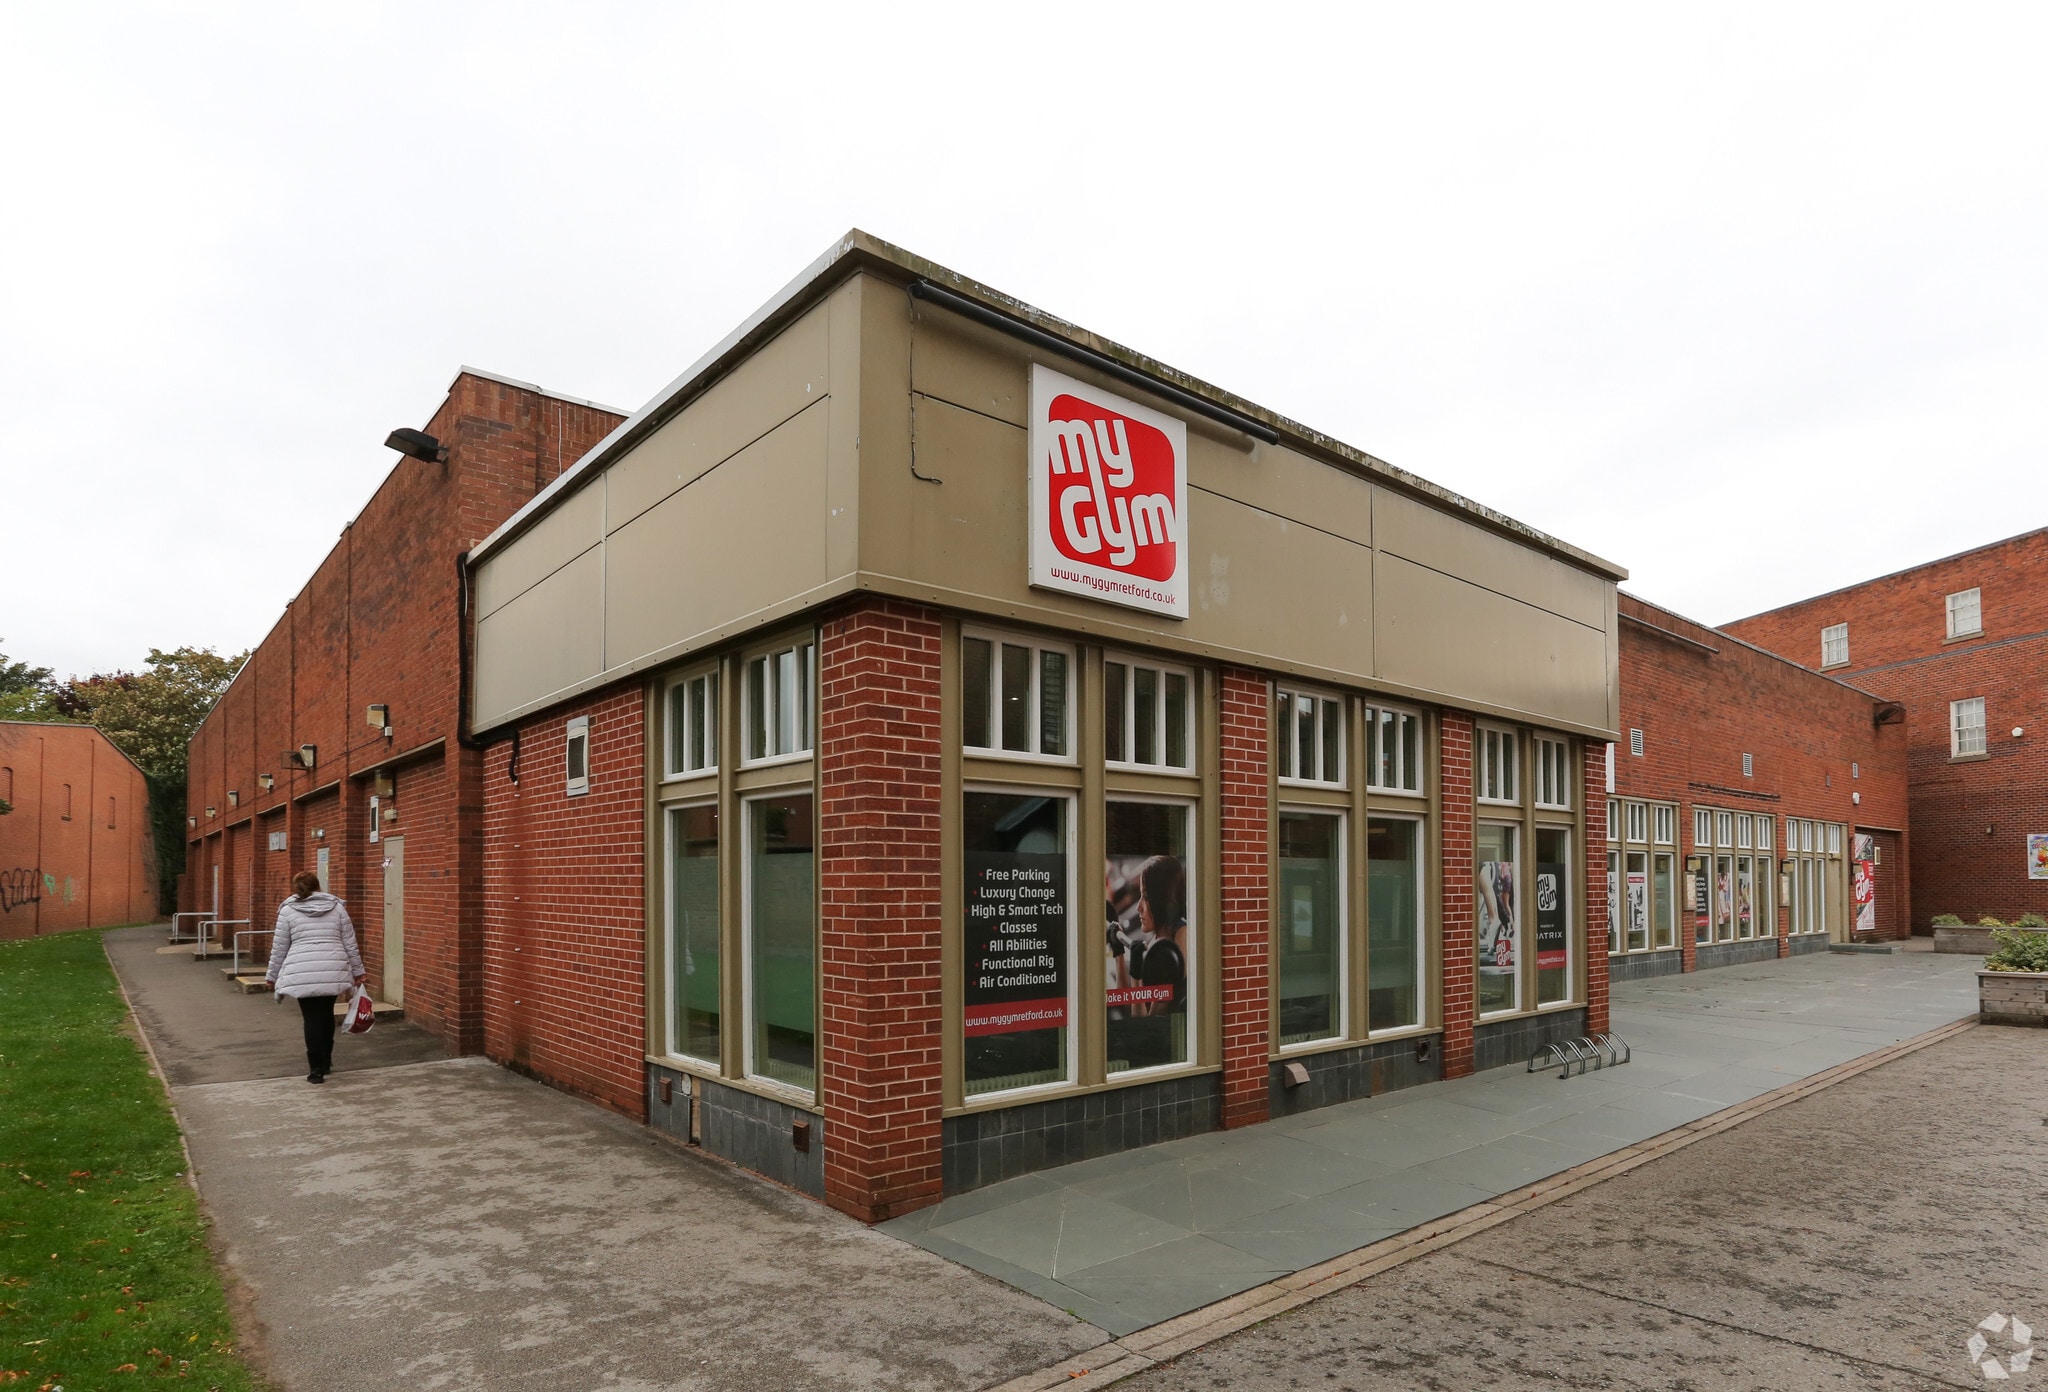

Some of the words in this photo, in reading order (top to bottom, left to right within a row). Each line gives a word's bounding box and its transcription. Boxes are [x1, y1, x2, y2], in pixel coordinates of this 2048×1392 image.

[1049, 418, 1135, 488] my
[1060, 484, 1177, 567] Gym
[1050, 567, 1176, 606] www.mygymretford.co.uk
[986, 868, 1009, 880] Free
[1012, 868, 1050, 883] Parking
[980, 886, 1016, 901] Luxury
[1019, 886, 1055, 900] Change
[971, 904, 996, 919] High
[998, 904, 1006, 916] &
[1008, 904, 1038, 916] Smart
[1040, 903, 1063, 915] Tech
[1000, 921, 1037, 934] Classes
[989, 939, 1003, 952] All
[1006, 938, 1047, 951] Abilities
[982, 955, 1036, 970] Functional
[1038, 954, 1054, 968] Rig
[979, 976, 995, 988] Air
[997, 971, 1056, 987] Conditioned
[1123, 991, 1129, 1002] it
[1130, 988, 1152, 1001] YOUR
[1153, 988, 1169, 1000] Gym
[965, 1007, 1063, 1027] www.mygymretford.co.uk
